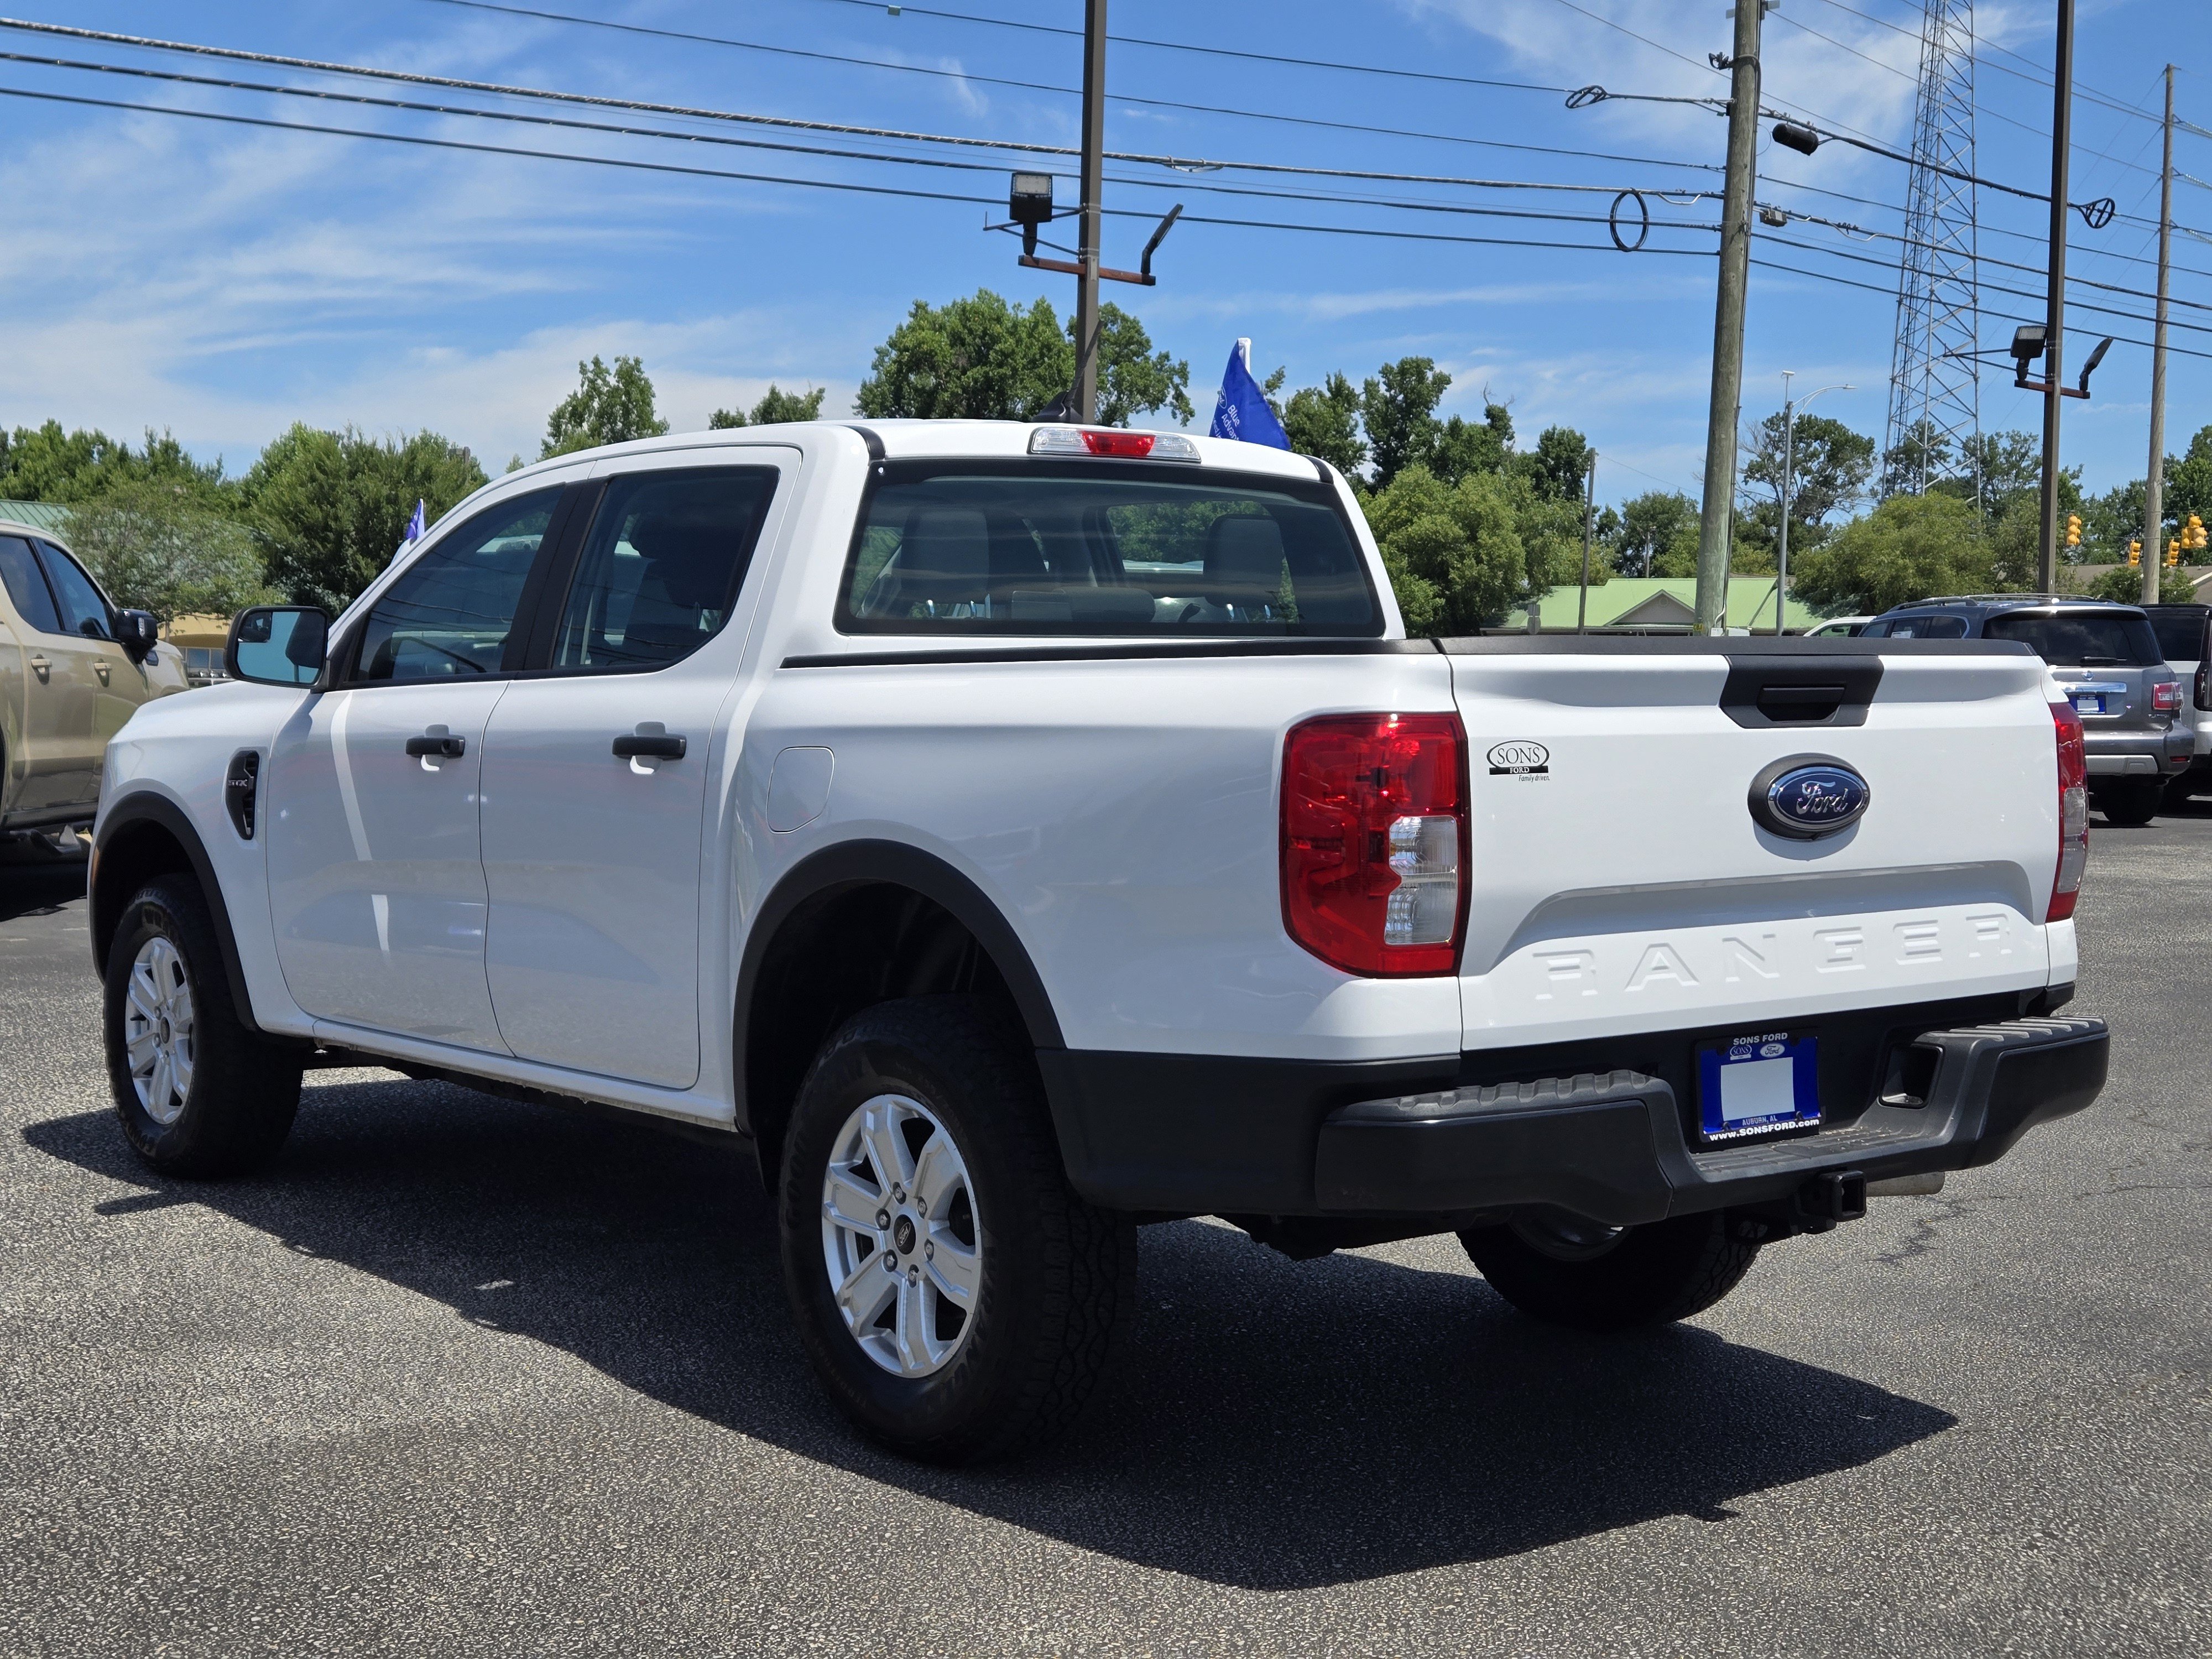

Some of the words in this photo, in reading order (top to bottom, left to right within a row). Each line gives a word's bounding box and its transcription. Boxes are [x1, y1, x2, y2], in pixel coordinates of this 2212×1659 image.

[1227, 404, 1240, 427] Blue
[1497, 747, 1540, 764] SONS
[1796, 780, 1849, 815] Ford
[1532, 913, 2013, 1000] RANGER
[1733, 1035, 1760, 1045] SONS
[1762, 1032, 1788, 1042] FORD
[1732, 1046, 1749, 1056] SONS
[1765, 1045, 1781, 1055] Ford
[1709, 1119, 1819, 1141] www.SONSFORD.com
[899, 1225, 909, 1244] Ford
